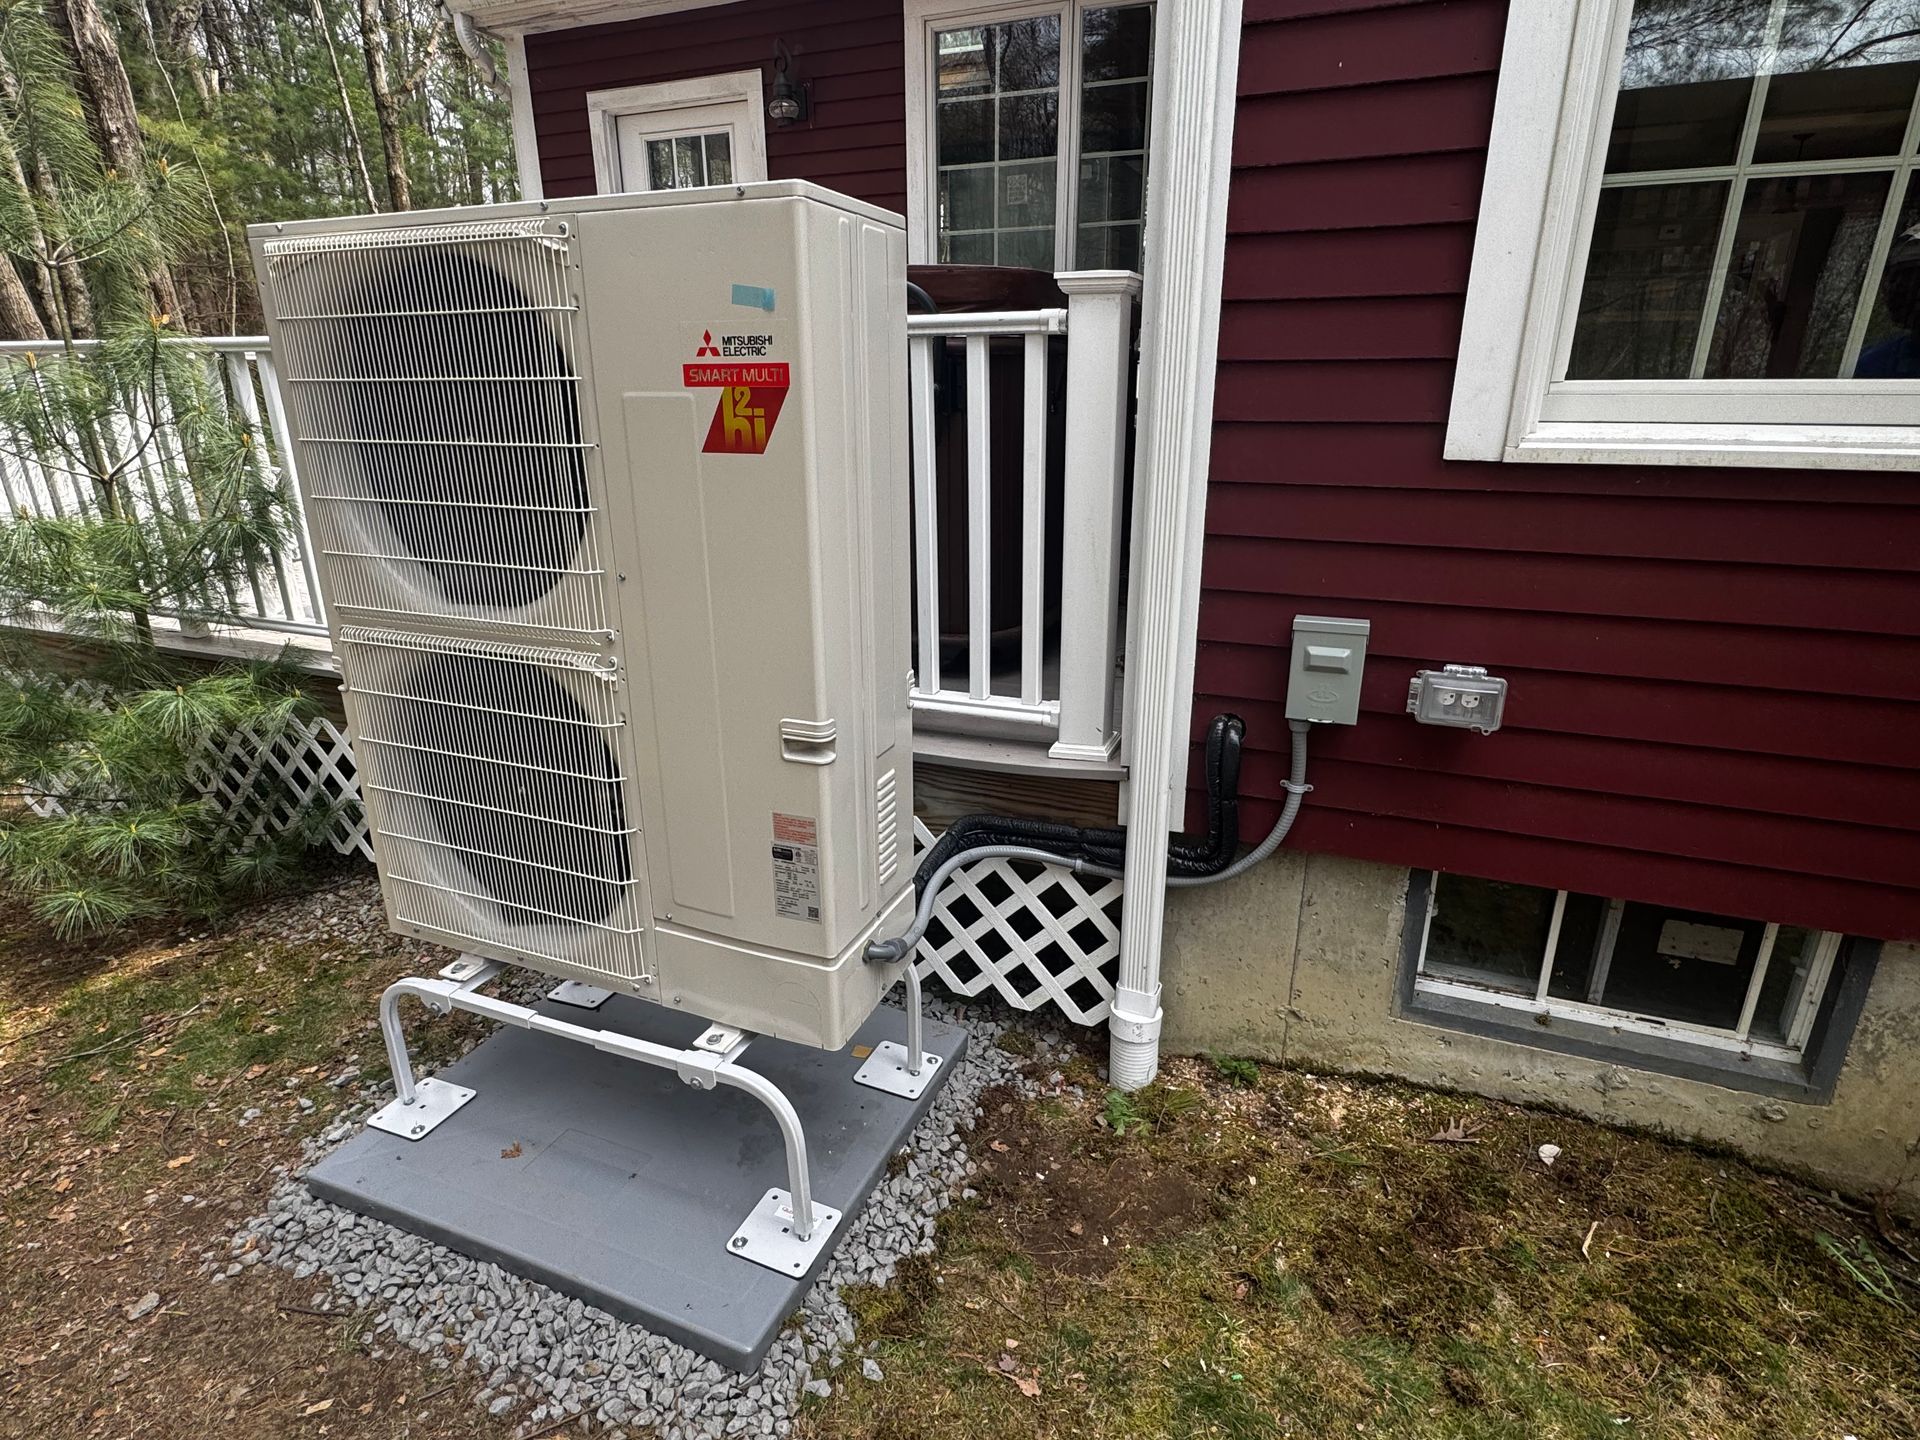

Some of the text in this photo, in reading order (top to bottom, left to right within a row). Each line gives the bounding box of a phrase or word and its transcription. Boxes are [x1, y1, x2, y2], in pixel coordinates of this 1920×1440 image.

[722, 335, 773, 346] MITSUBISHI
[722, 347, 767, 357] ELECTRIC
[689, 367, 784, 382] SMART MULTI
